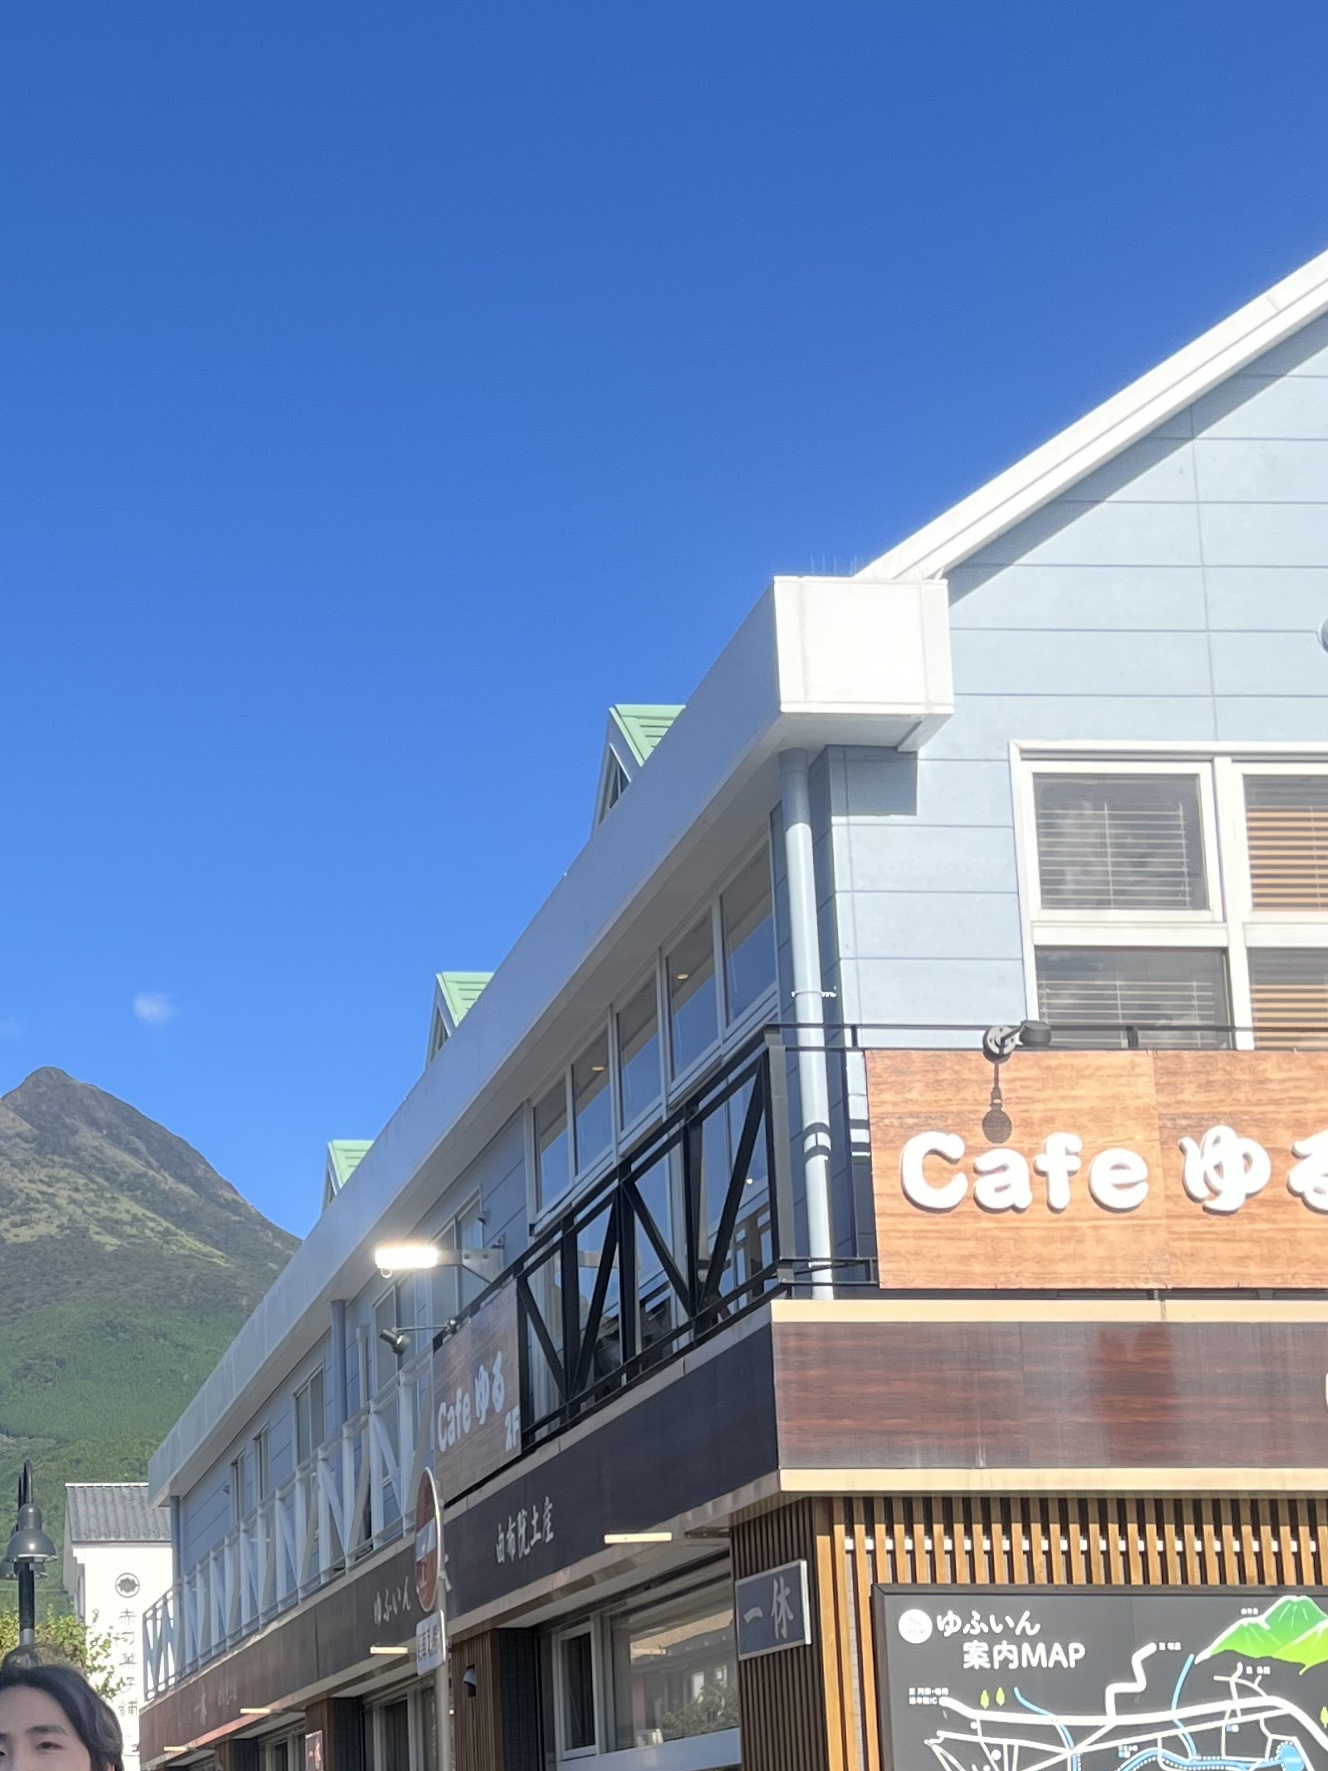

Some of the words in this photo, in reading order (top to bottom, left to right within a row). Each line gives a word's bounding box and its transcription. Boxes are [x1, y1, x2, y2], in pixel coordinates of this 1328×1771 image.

[901, 1130, 1150, 1214] Cafe
[437, 1387, 471, 1453] Cafe
[475, 1351, 504, 1426] ゆる
[504, 1405, 520, 1452] 2F
[495, 1496, 554, 1564] 由布院土産
[374, 1576, 411, 1626] ゆふいん
[743, 1575, 794, 1640] 一休
[936, 1610, 1041, 1637] ゆふいん
[963, 1640, 1086, 1669] 案内MAP
